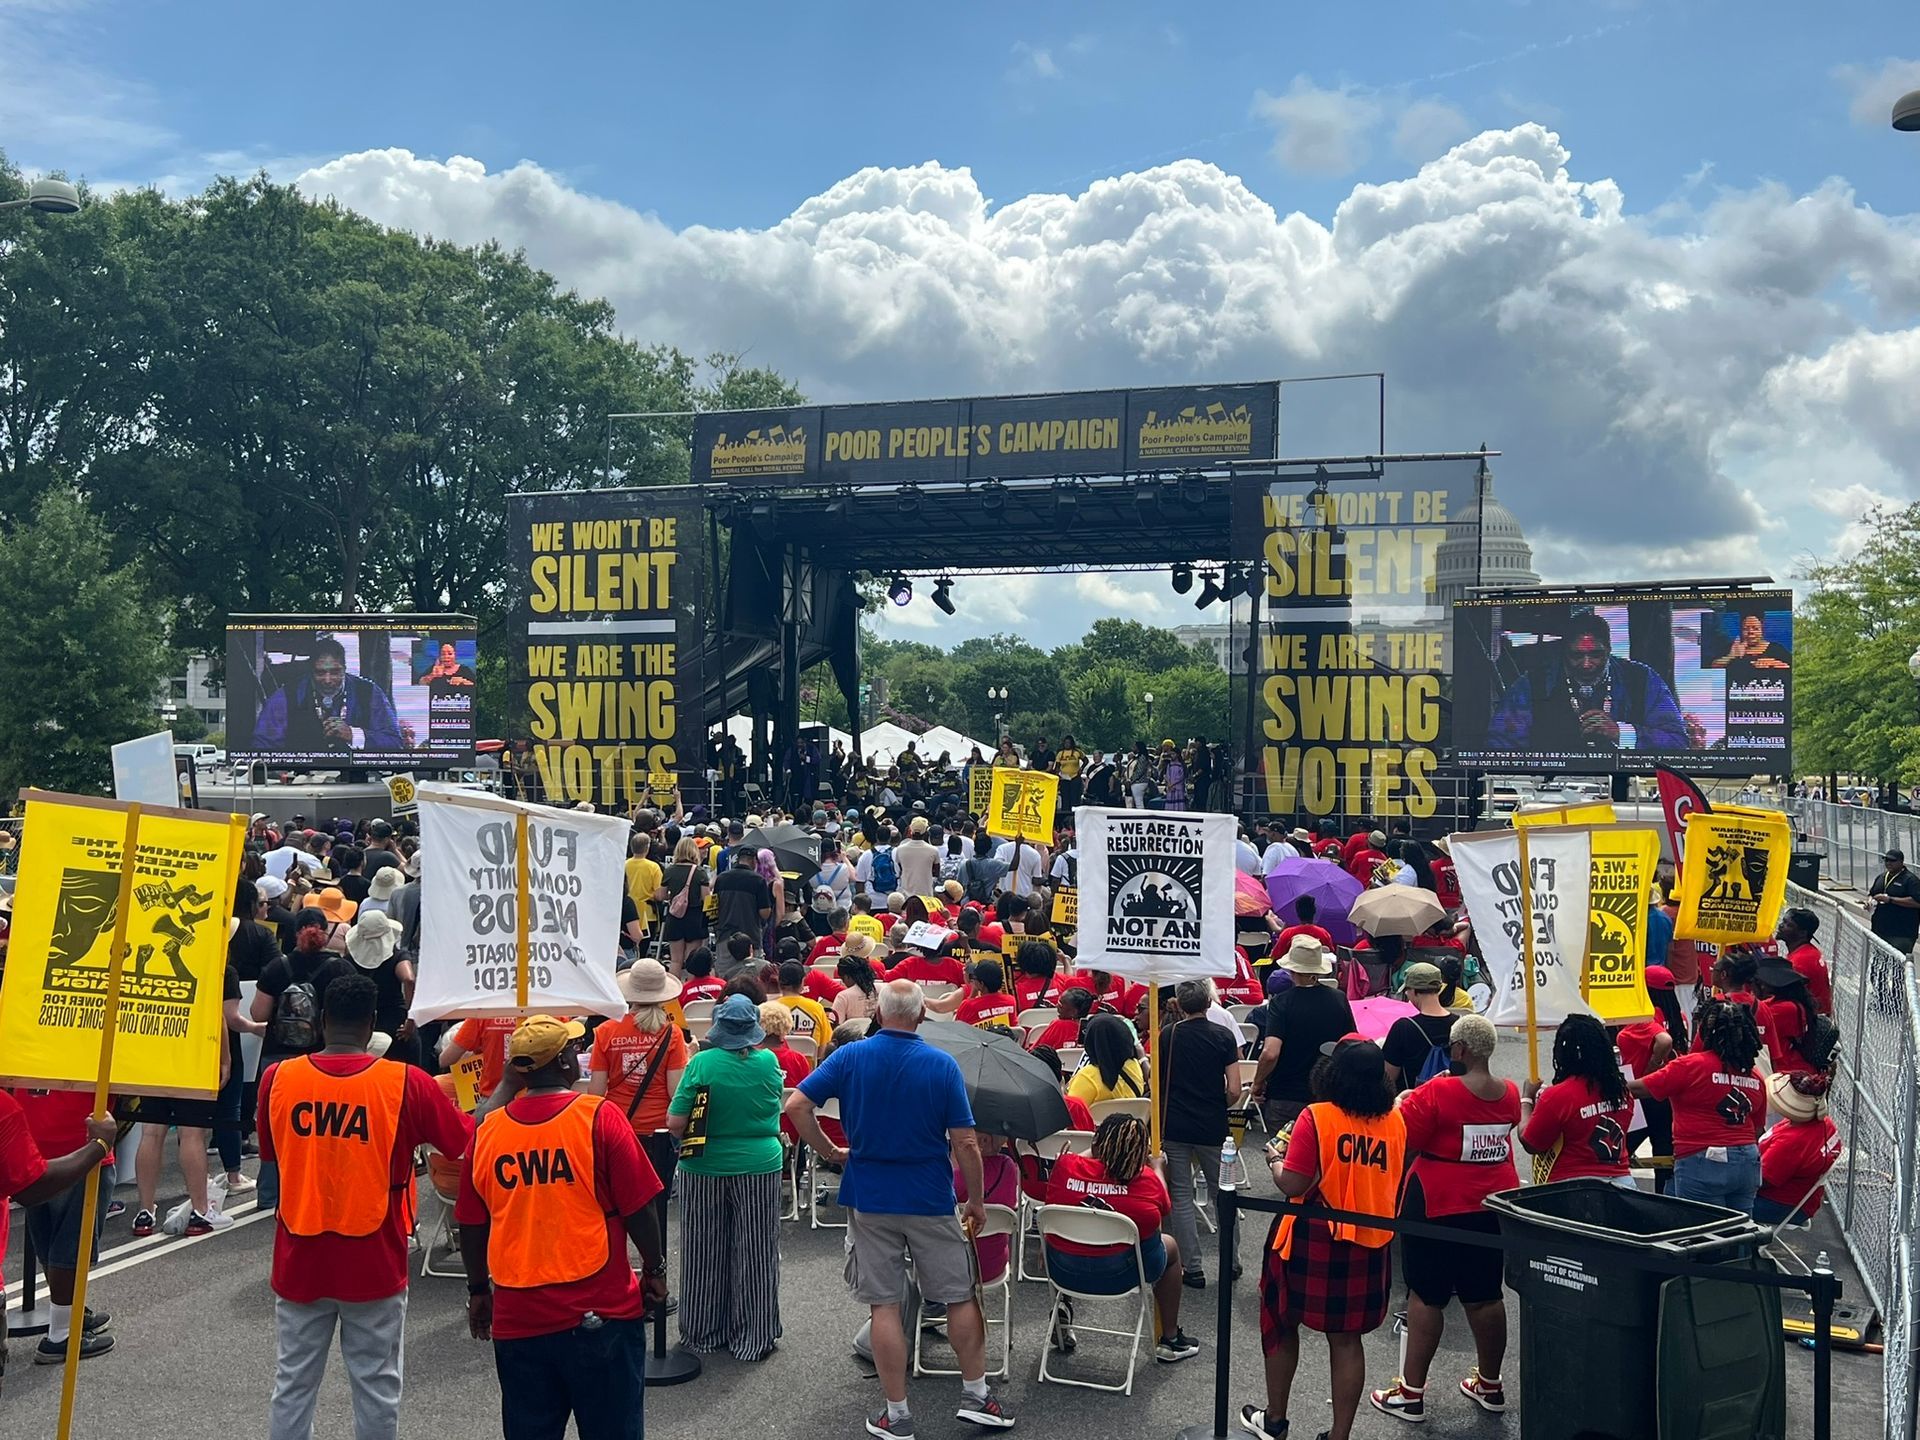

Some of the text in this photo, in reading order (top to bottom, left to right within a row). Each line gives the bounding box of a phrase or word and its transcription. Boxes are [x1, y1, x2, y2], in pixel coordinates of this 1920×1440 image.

[825, 418, 1119, 462] POOR PEOPLE'S CAMPAIGN
[1142, 432, 1248, 445] Poor People's Campaign
[713, 453, 803, 465] Poor People's Campaign
[1263, 490, 1448, 528] WE WON'T BE
[531, 518, 677, 552] WE WON'T BE
[1264, 528, 1447, 598] SILENT
[530, 552, 678, 613] SILENT
[528, 644, 676, 677] WE ARE THE
[1262, 633, 1443, 670] WE ARE THE
[528, 680, 676, 741] SWING
[1262, 674, 1440, 743] SWING
[533, 744, 677, 806] VOTES
[1263, 746, 1438, 818] VOTES
[1107, 837, 1203, 855] RESURRECTION
[1120, 822, 1189, 837] WE ARE A
[1711, 827, 1771, 838] WAKING THE
[1107, 918, 1201, 939] NOT AN
[1107, 937, 1201, 950] INSURRECTION
[611, 1036, 637, 1046] CEDAR
[1712, 1071, 1760, 1092] CWA ACTIVISTS
[291, 1101, 369, 1143] CWA
[494, 1147, 576, 1190] CWA
[1337, 1133, 1388, 1171] CWA
[1470, 1146, 1507, 1160] RIGHTS
[1066, 1178, 1129, 1196] CWA ACTIVISTS
[1529, 1260, 1599, 1286] DISTRICT OF COLUMBIA
[1543, 1273, 1585, 1291] GOVERNMENT
